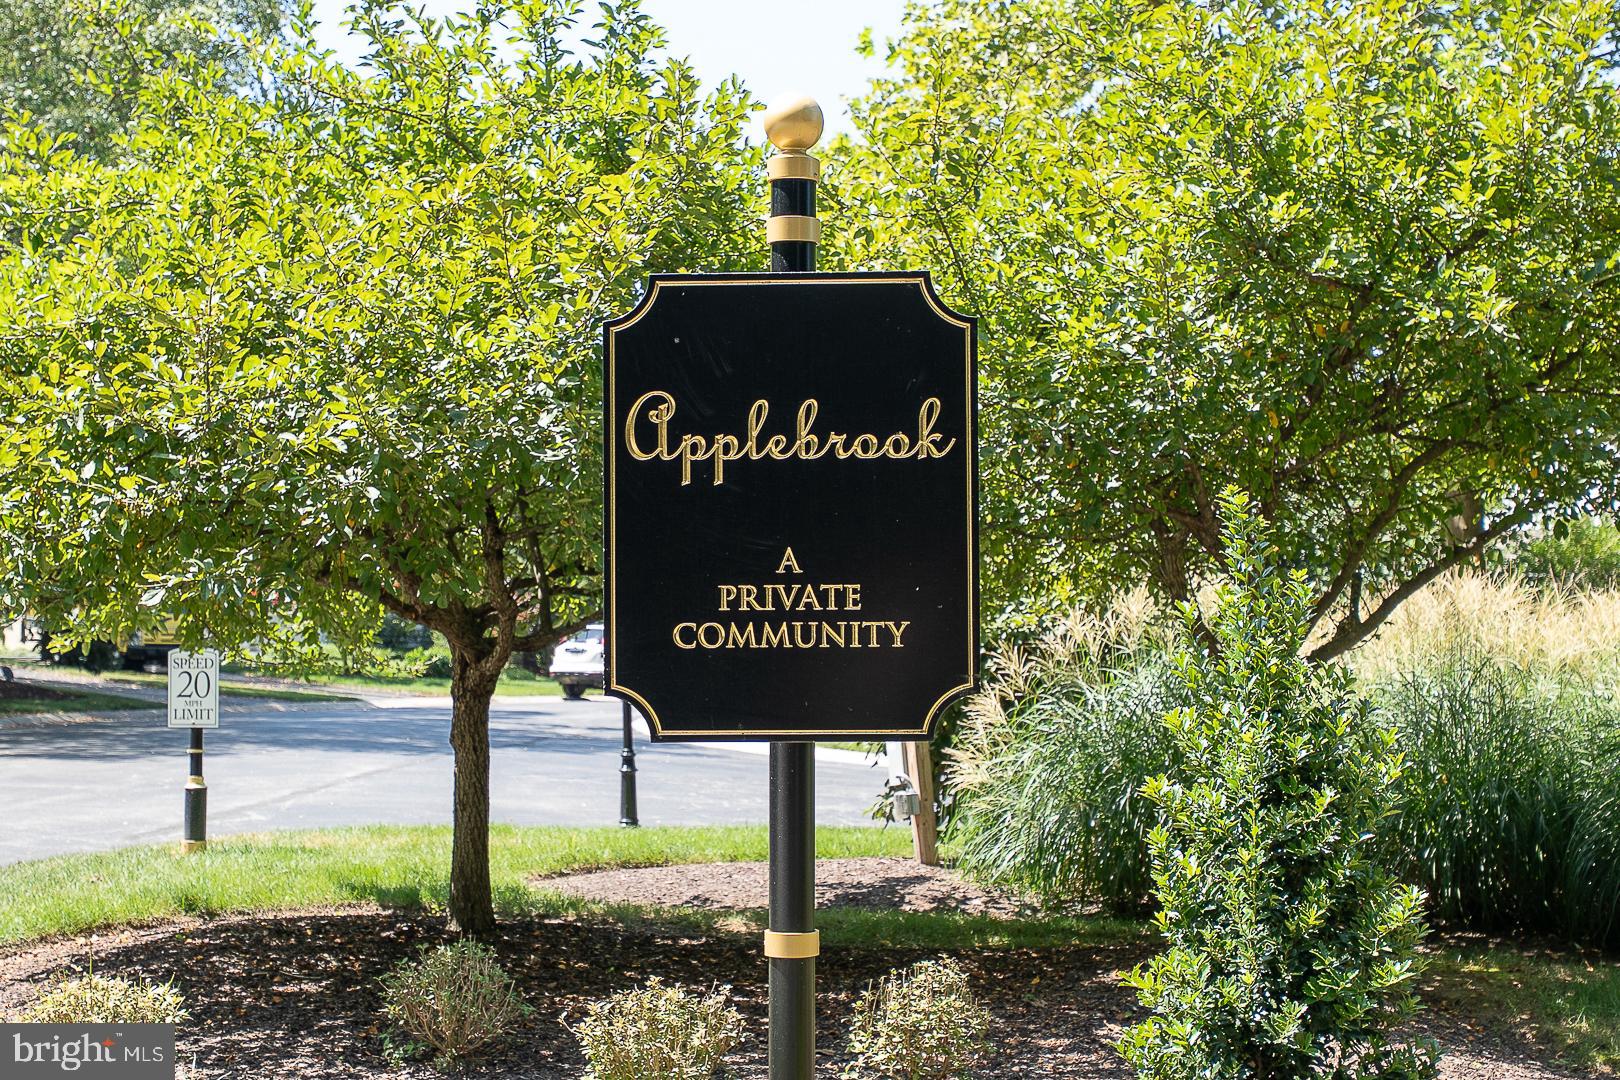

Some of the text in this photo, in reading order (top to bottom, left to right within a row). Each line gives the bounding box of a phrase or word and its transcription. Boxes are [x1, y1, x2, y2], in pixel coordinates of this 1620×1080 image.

[624, 390, 957, 486] Applebrook
[776, 546, 803, 574] A
[717, 583, 862, 612] PRIVATE
[672, 620, 911, 650] COMMUNITY
[172, 657, 214, 670] SPEED
[176, 670, 211, 699] 20
[173, 708, 214, 721] LIMIT
[184, 700, 203, 708] MPH
